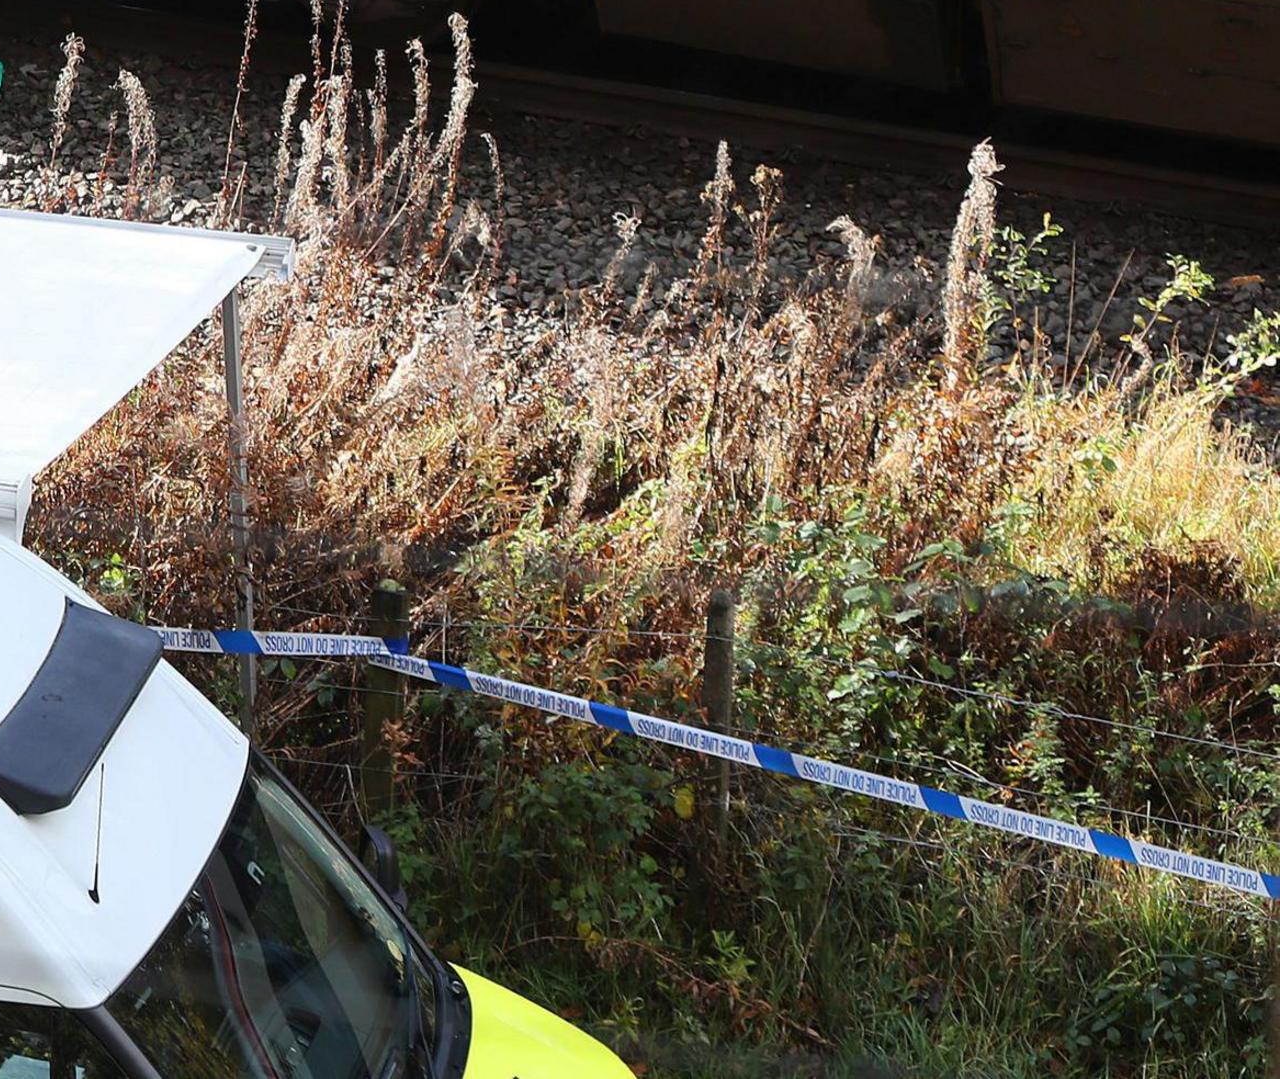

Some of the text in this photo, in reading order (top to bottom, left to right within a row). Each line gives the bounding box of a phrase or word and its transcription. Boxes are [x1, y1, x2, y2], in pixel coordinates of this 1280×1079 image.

[181, 631, 211, 648] POLICE
[265, 634, 294, 653] CROSS
[295, 636, 315, 653] NOT
[315, 637, 328, 654] DO
[329, 638, 349, 655] LINE
[474, 676, 586, 719] POLICE LINE DO NOT CROSS
[638, 718, 750, 761] POLICE LINE DO NOT CROSS
[802, 761, 917, 804] POLICE LINE DO NOT CROSS
[970, 804, 1087, 846] POLICE LINE DO NOT CROSS
[1141, 847, 1258, 891] POLICE LINE DO NOT CROSS
